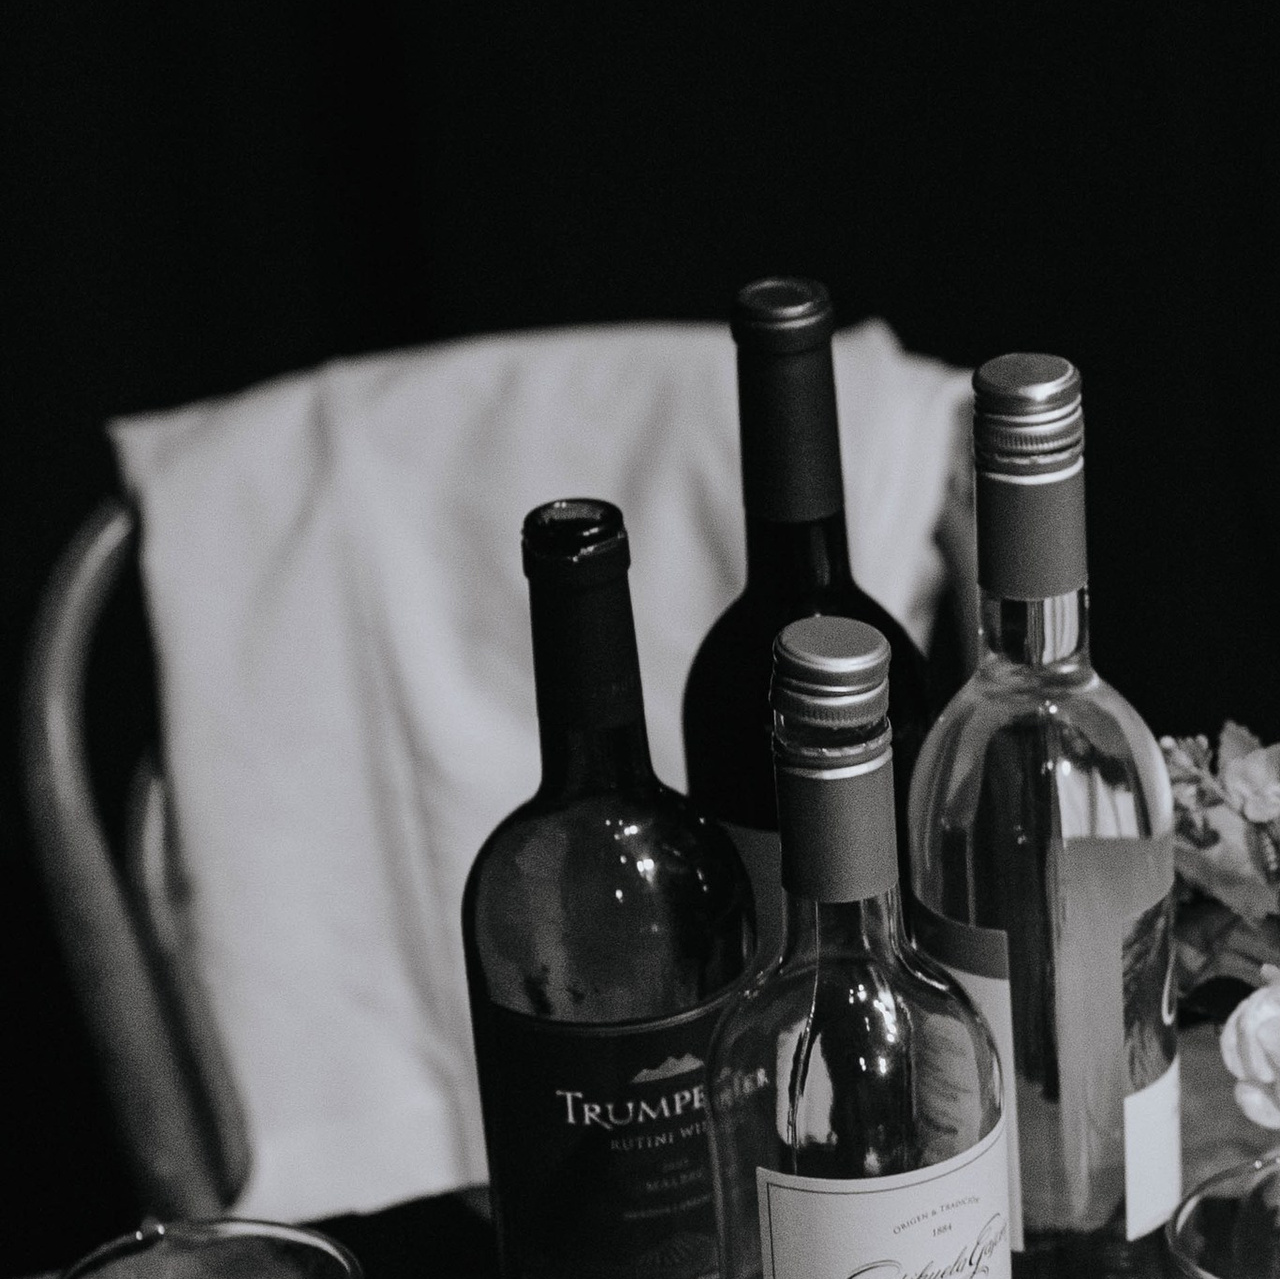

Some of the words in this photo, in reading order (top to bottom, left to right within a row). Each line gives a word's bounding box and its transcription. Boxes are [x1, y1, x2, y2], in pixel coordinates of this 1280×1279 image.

[555, 1084, 706, 1130] TRUMPE
[609, 1131, 675, 1151] RUTINI
[893, 1212, 929, 1235] ORIGEN
